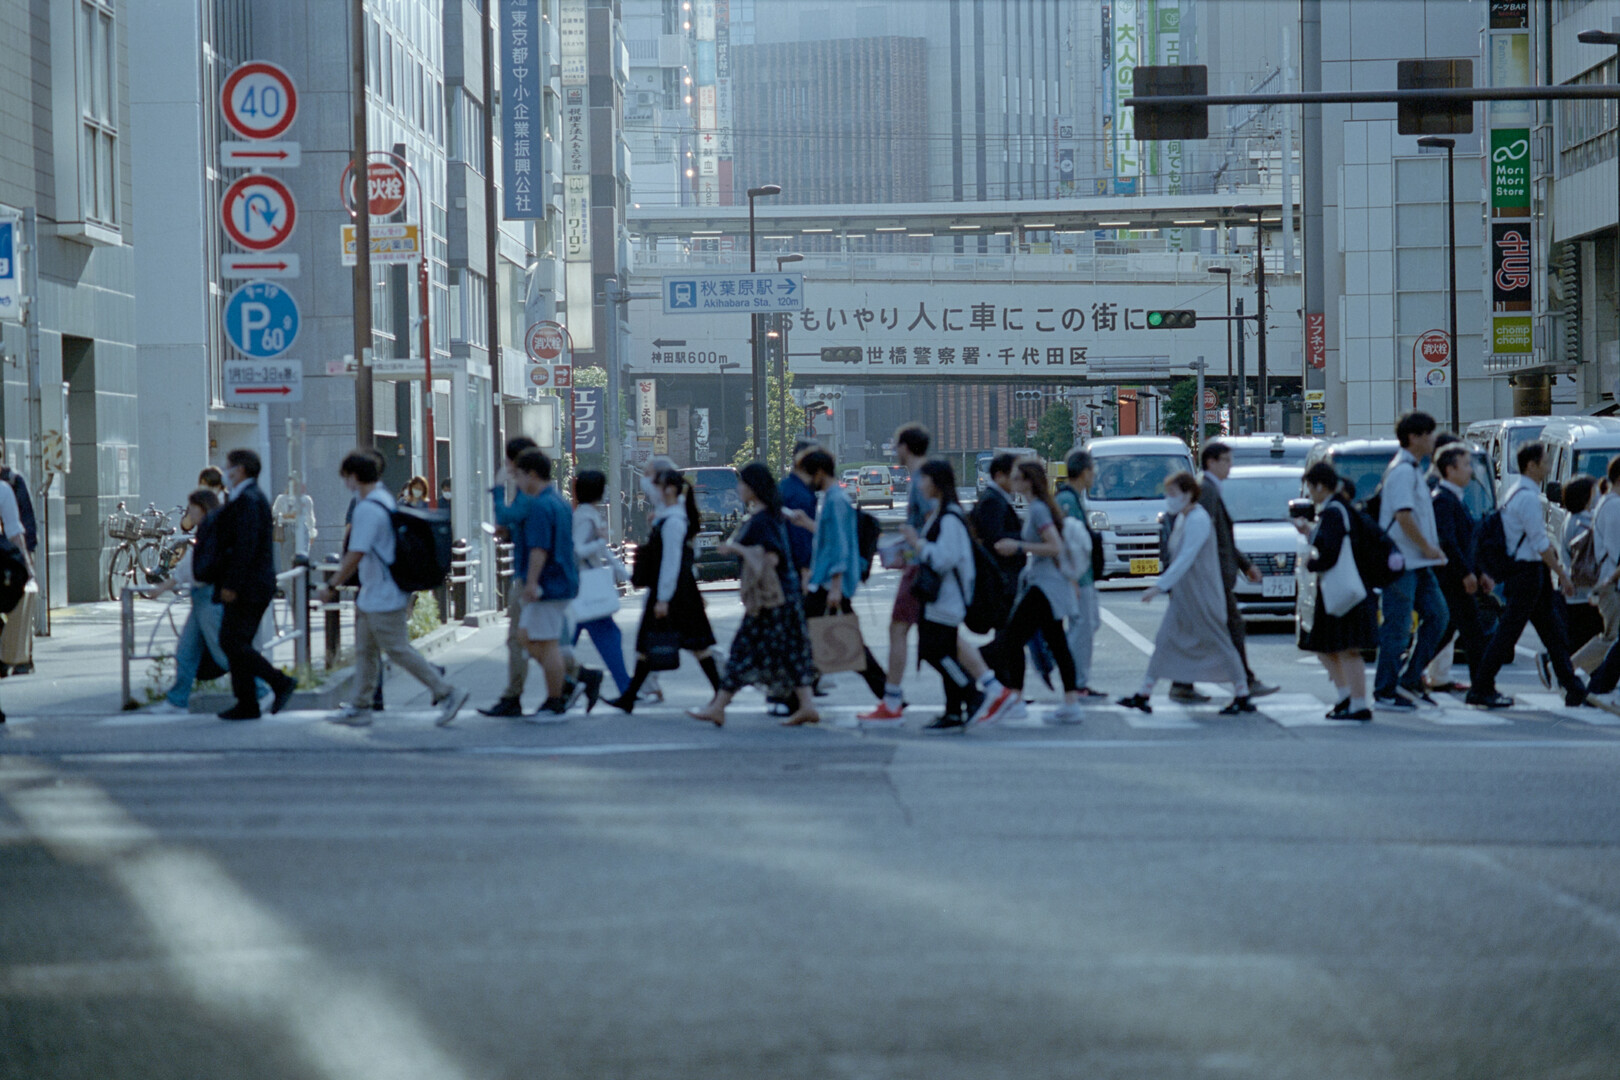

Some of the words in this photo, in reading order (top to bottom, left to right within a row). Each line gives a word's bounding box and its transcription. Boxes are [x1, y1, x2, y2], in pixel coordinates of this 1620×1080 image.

[240, 85, 280, 118] 40
[511, 11, 532, 212] 東京都中小企業振興公社
[1496, 165, 1524, 175] Mori
[1496, 175, 1524, 185] Mori
[367, 177, 402, 200] 火栓
[1496, 186, 1524, 196] Store
[1495, 230, 1529, 291] HUB
[700, 278, 773, 296] 秋葉原駅
[704, 298, 750, 309] Akihabara
[753, 297, 771, 308] Sta.
[778, 296, 799, 307] 120m
[241, 302, 271, 351] P
[1496, 325, 1530, 337] chomp
[261, 327, 284, 351] 60
[534, 337, 562, 350] 消火栓
[1496, 335, 1530, 347] chomp
[866, 345, 1088, 365] 世橋警察署・千代田区
[1423, 344, 1448, 354] 消火栓
